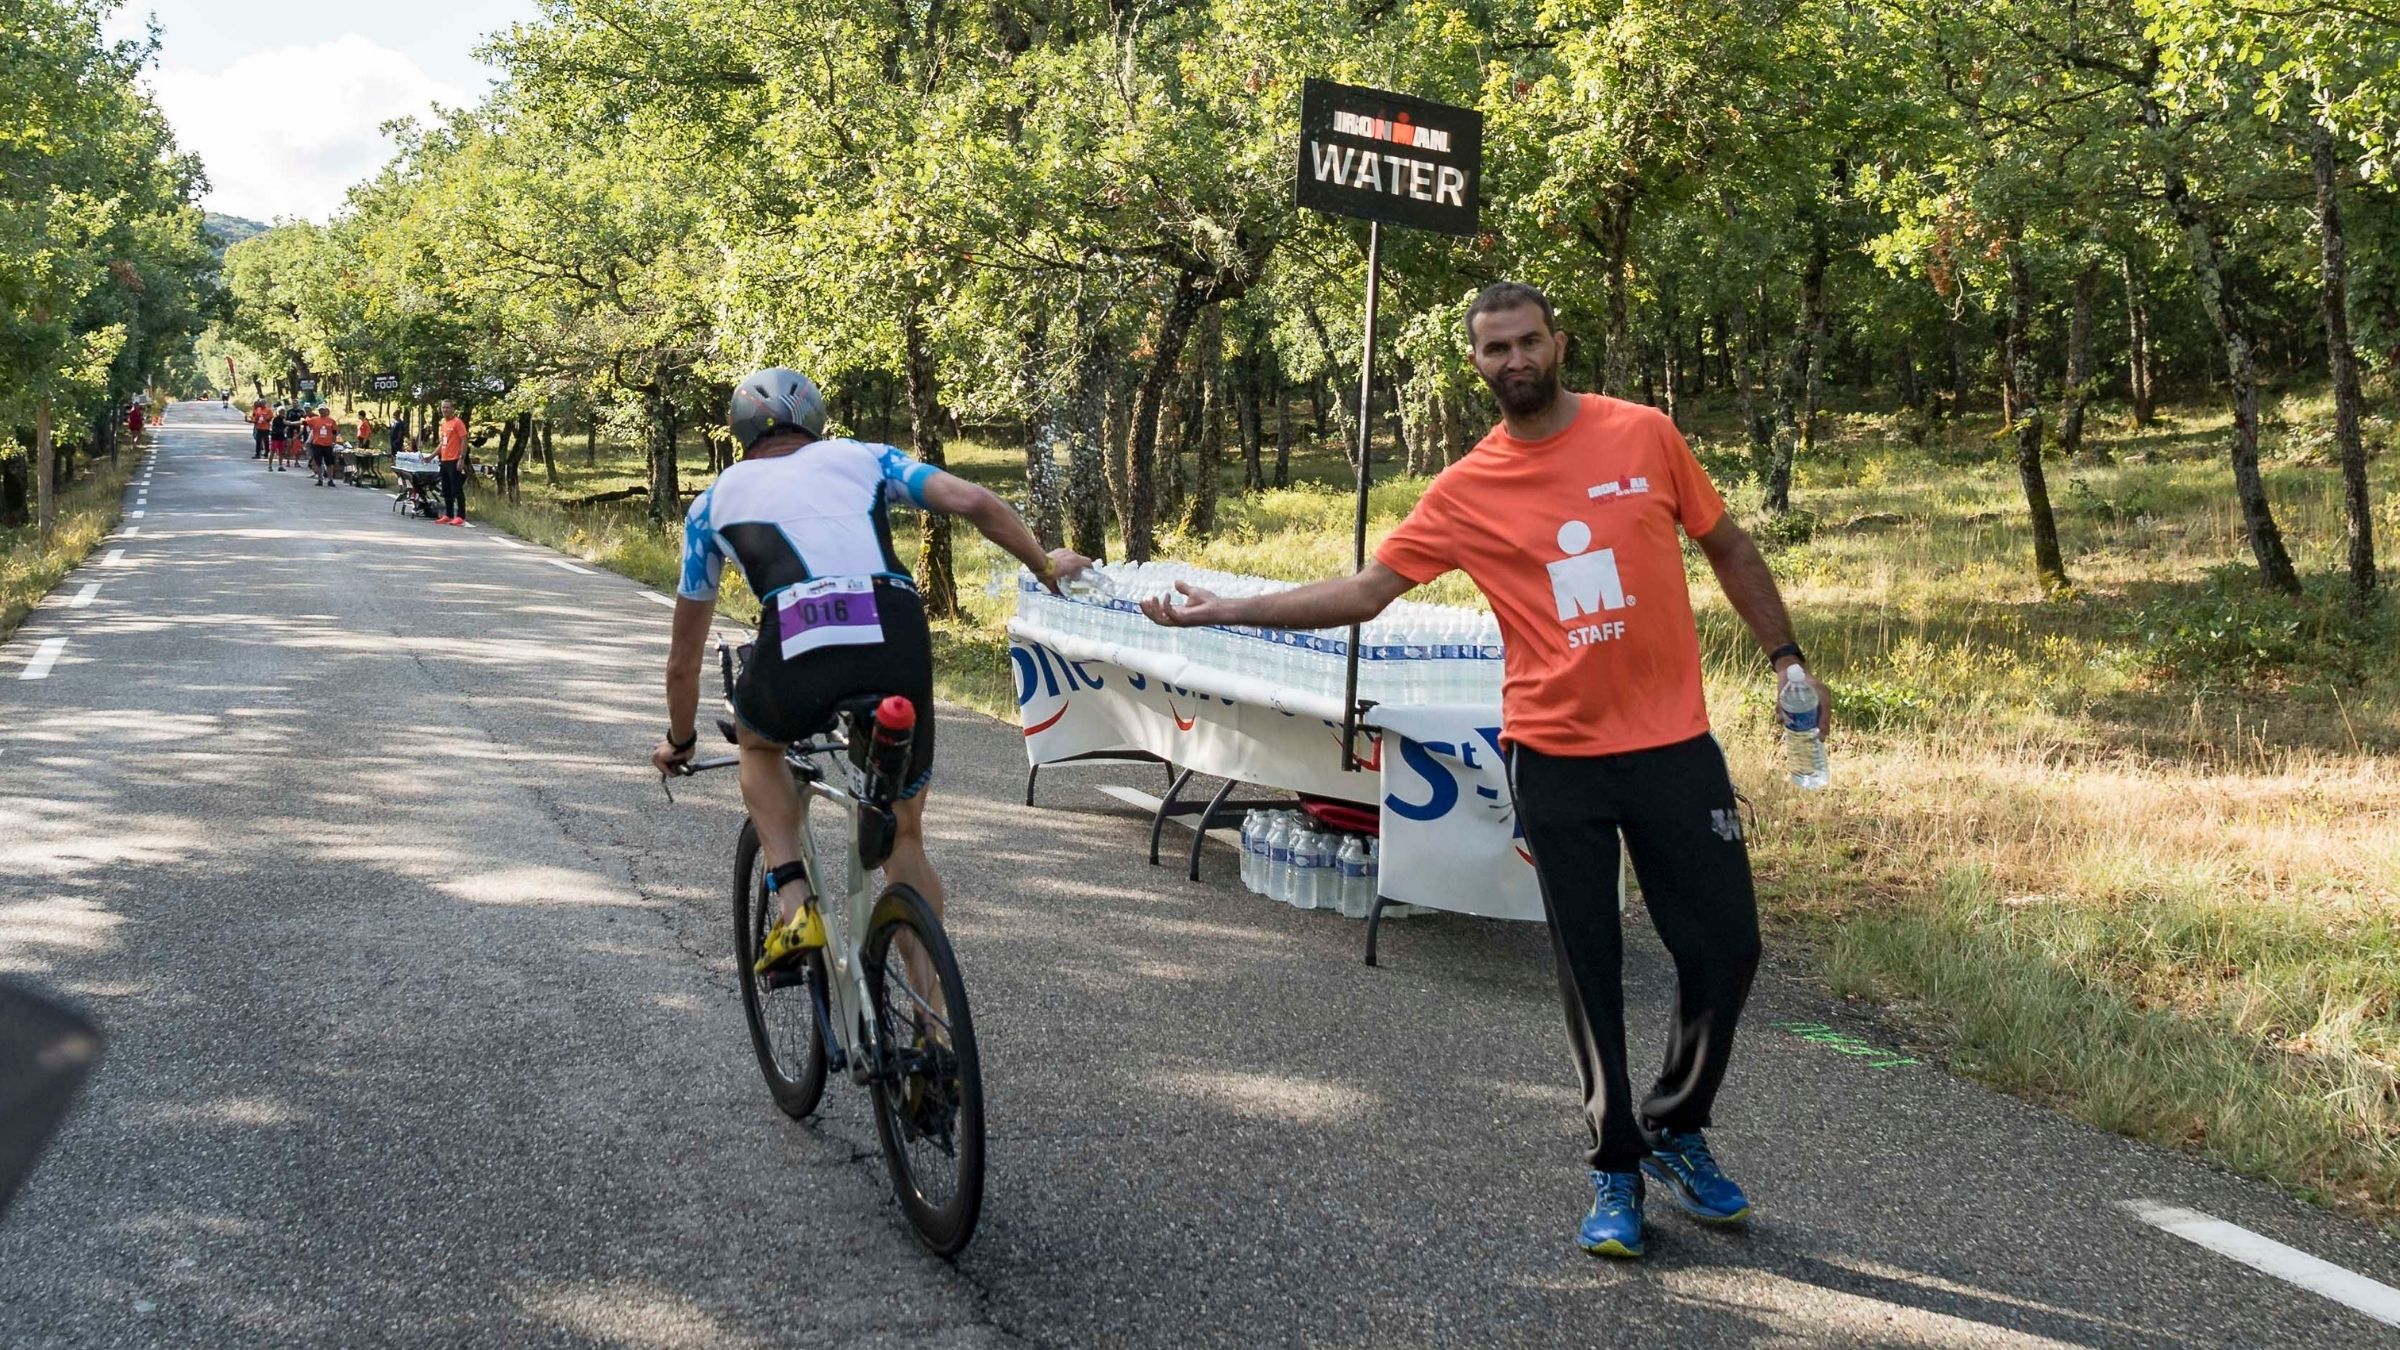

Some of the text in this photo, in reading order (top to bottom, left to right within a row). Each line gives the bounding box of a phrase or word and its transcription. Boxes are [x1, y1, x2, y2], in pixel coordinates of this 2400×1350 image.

[1311, 140, 1465, 207] WATER
[374, 380, 398, 390] FOOD
[802, 599, 849, 625] 016
[1567, 620, 1626, 649] STAFF
